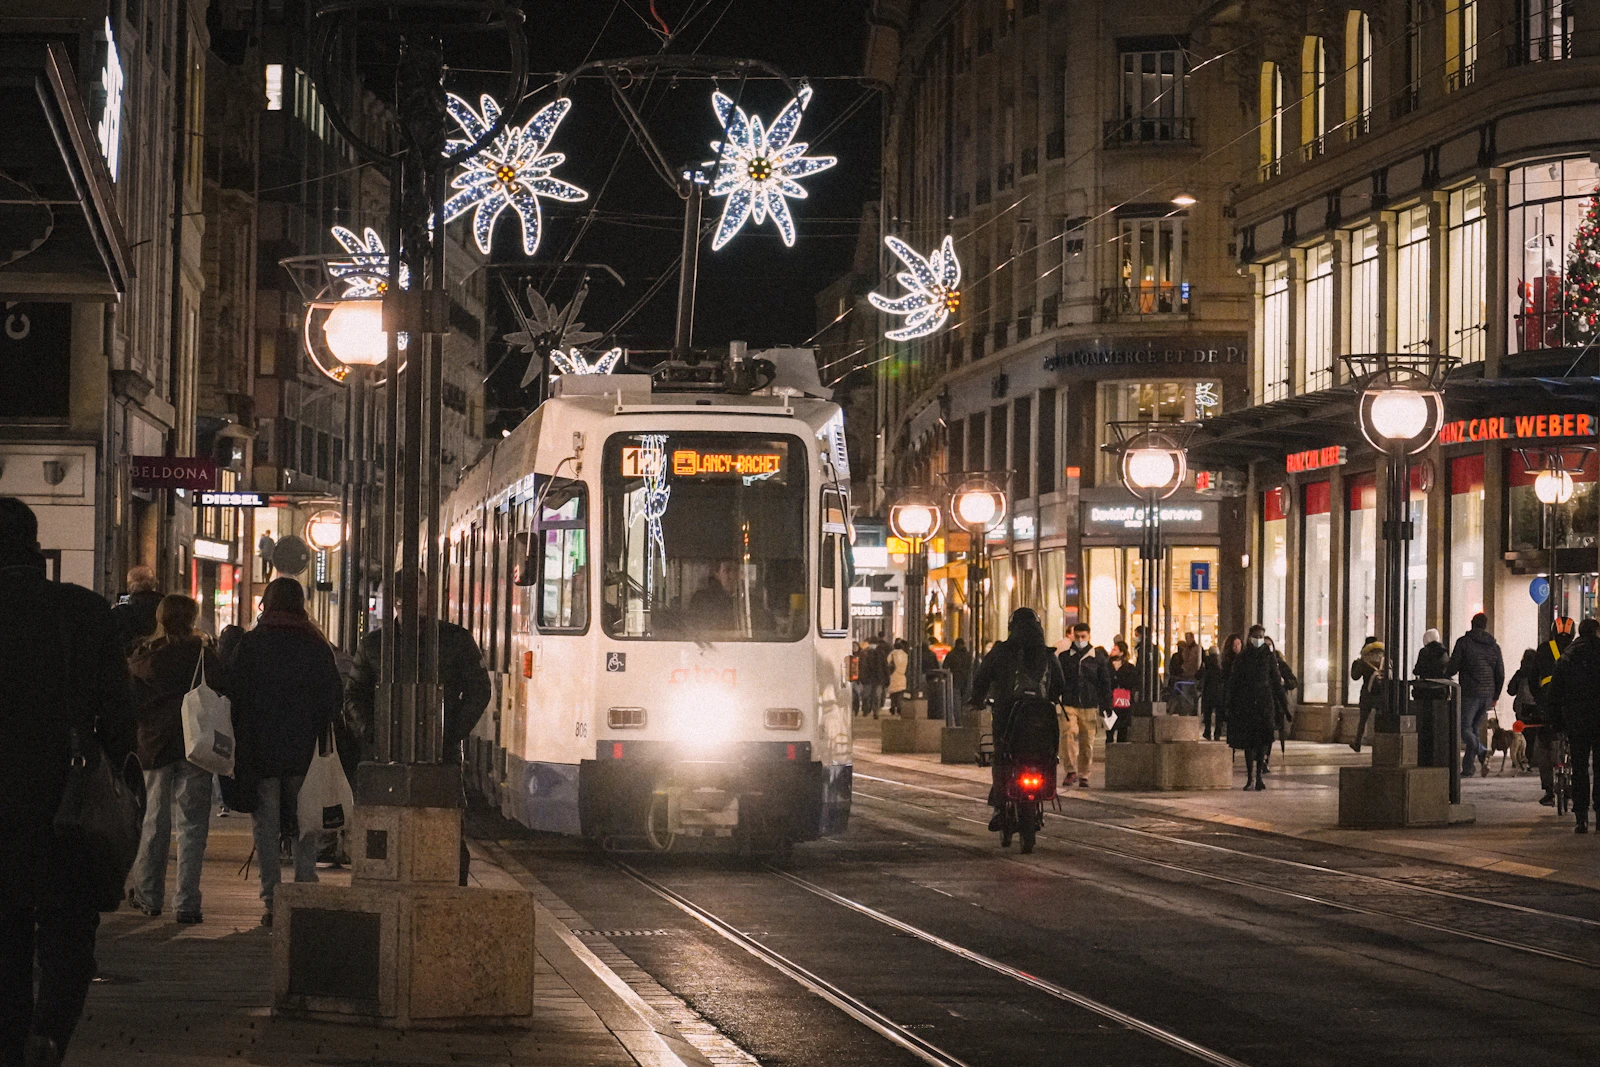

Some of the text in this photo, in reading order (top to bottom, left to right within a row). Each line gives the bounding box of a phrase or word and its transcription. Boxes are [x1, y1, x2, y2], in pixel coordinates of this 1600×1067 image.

[1073, 348, 1157, 366] COMMERCE
[1165, 350, 1187, 363] ET
[1192, 350, 1218, 363] DE
[1468, 416, 1508, 442] CARL
[1515, 413, 1591, 438] WEBER
[696, 454, 780, 473] LANCY-BACHET
[131, 466, 208, 480] BELDONA
[201, 494, 263, 505] DIESEL
[850, 605, 883, 616] GUESS
[575, 721, 588, 738] 806
